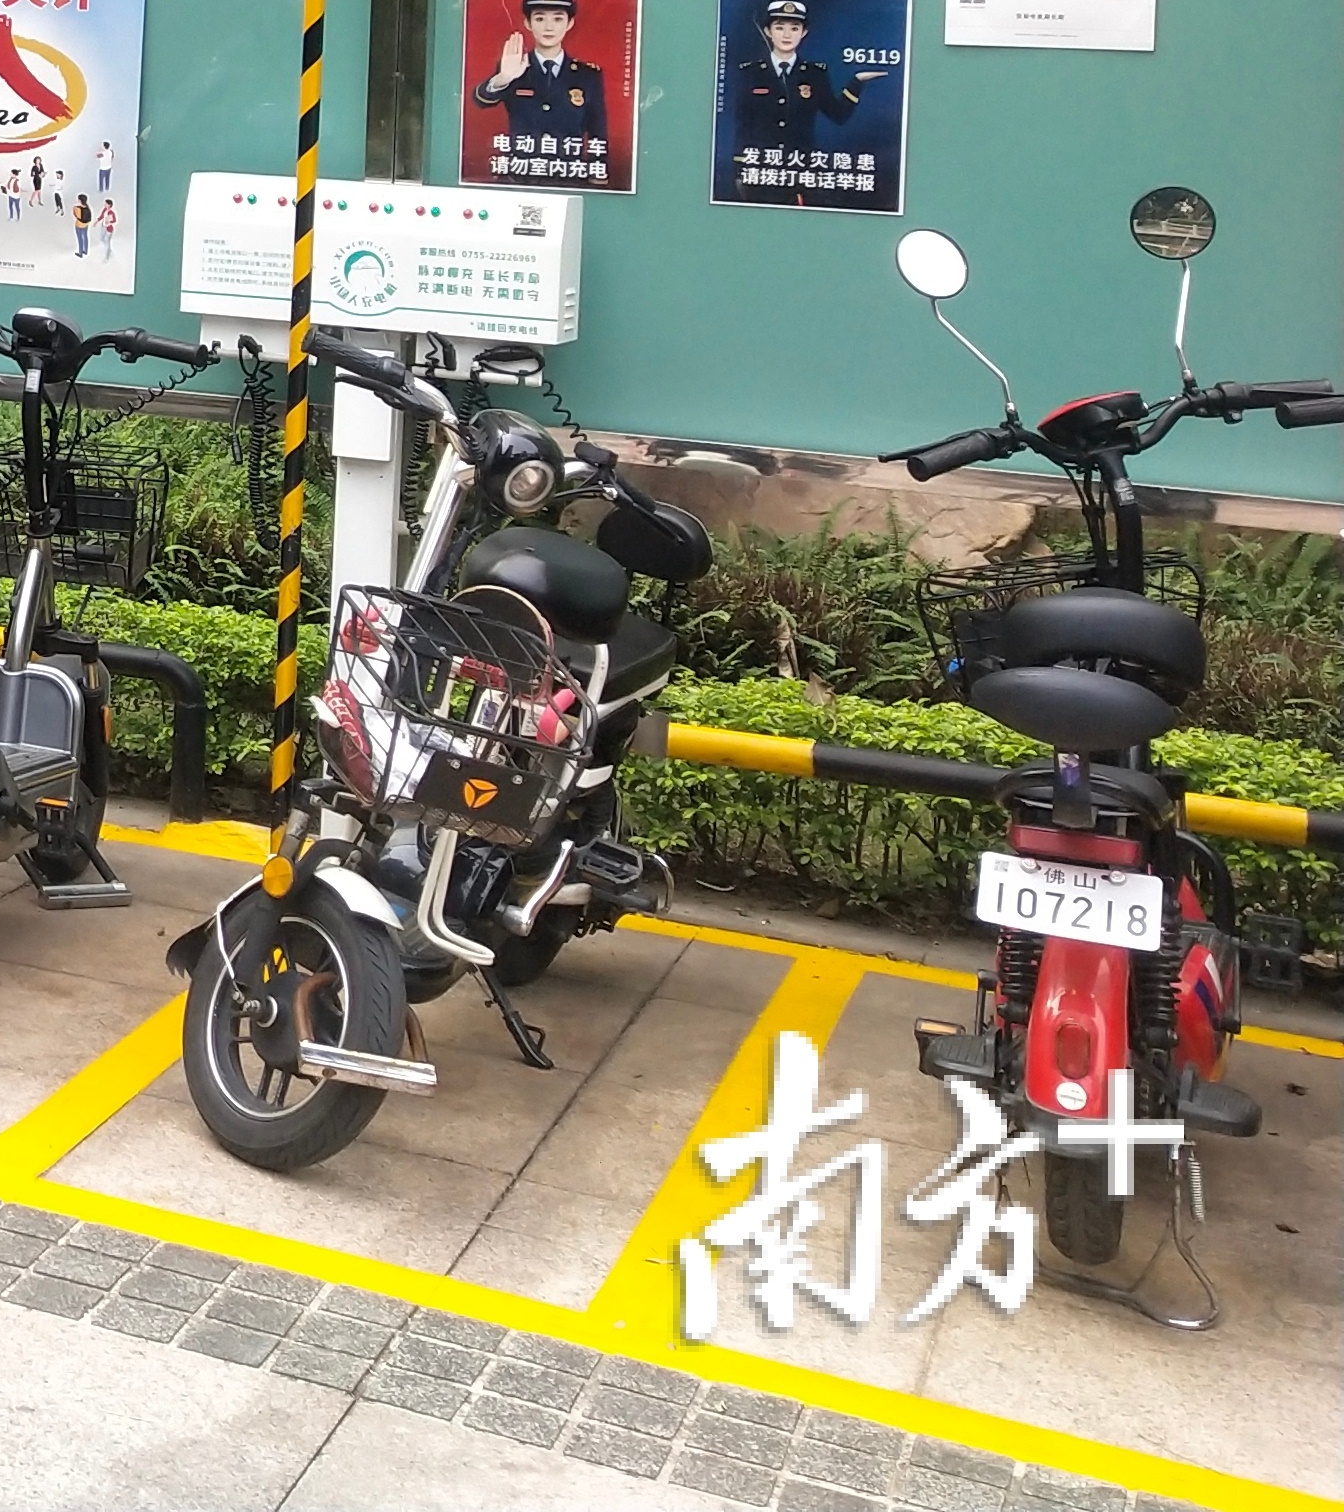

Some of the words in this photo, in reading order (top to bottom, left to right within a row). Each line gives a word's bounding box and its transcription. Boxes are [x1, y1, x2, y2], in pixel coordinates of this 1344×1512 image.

[842, 48, 901, 65] 96119
[493, 133, 608, 157] 电动自行车
[490, 155, 608, 179] 请勿室内充电
[742, 147, 875, 171] 发现火灾隐患
[740, 167, 875, 192] 请拨打电话举报
[461, 250, 536, 263] 0755-22226969
[483, 269, 540, 284] 延长寿命
[417, 282, 473, 297] 充满断电
[482, 286, 540, 302] 无需值守
[1043, 867, 1097, 890] 佛山
[996, 882, 1148, 936] 107218
